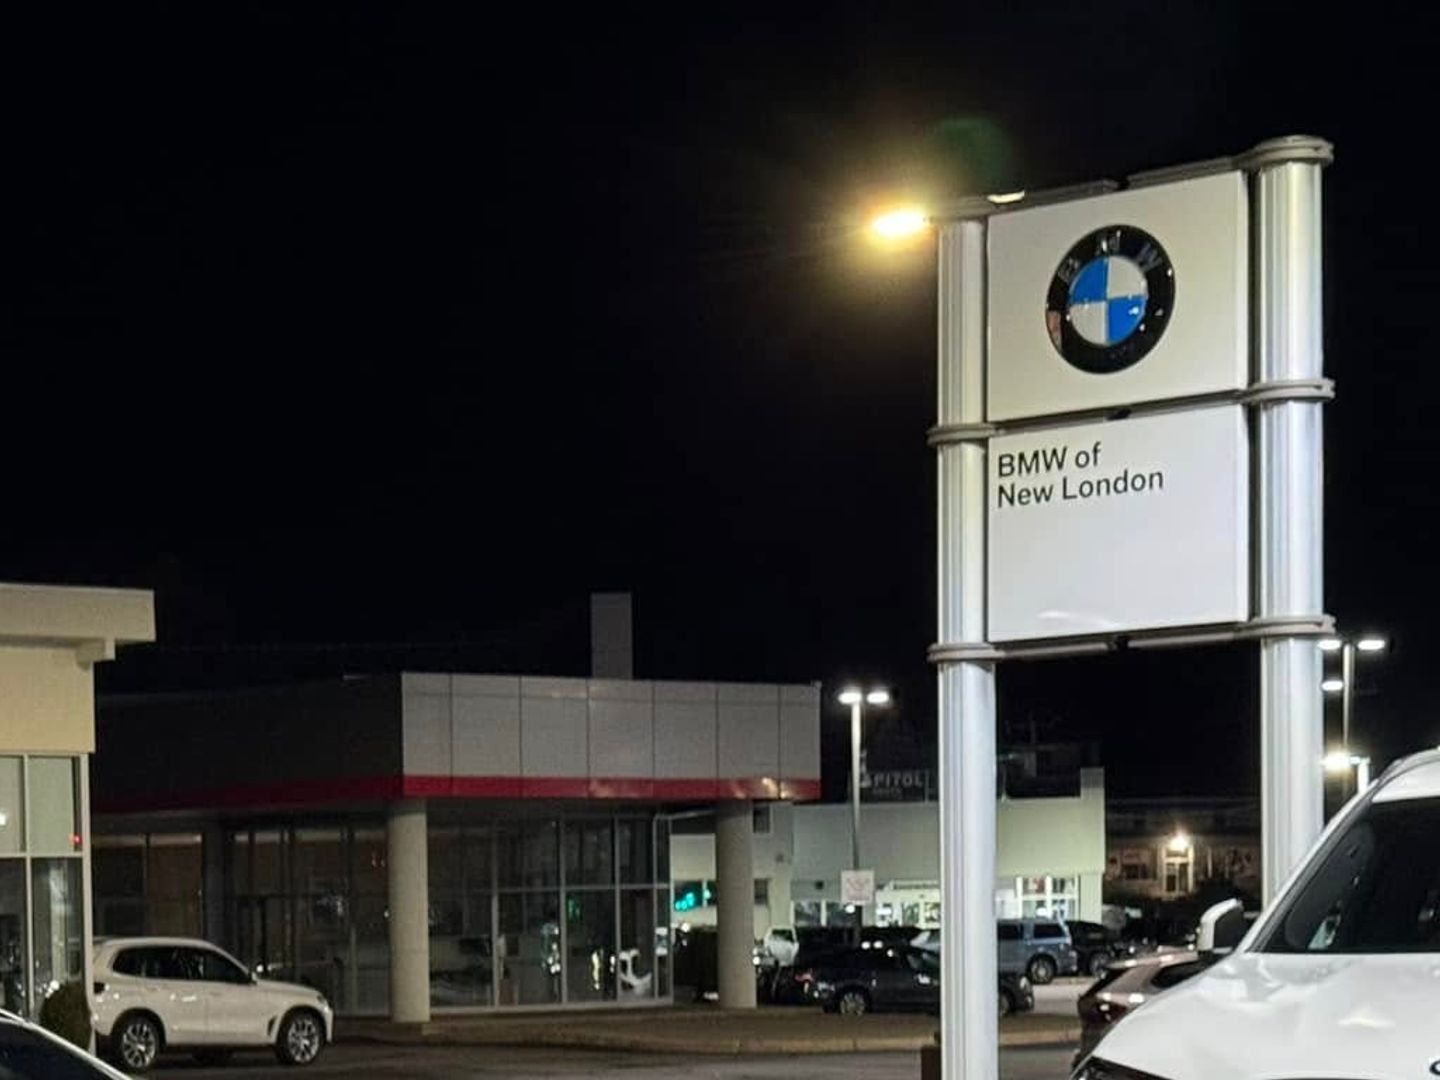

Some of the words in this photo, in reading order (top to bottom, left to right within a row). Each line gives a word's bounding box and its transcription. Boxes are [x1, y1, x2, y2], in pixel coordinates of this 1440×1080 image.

[998, 445, 1067, 478] BMW
[1075, 442, 1102, 468] of
[998, 483, 1053, 508] New
[1062, 469, 1164, 500] London
